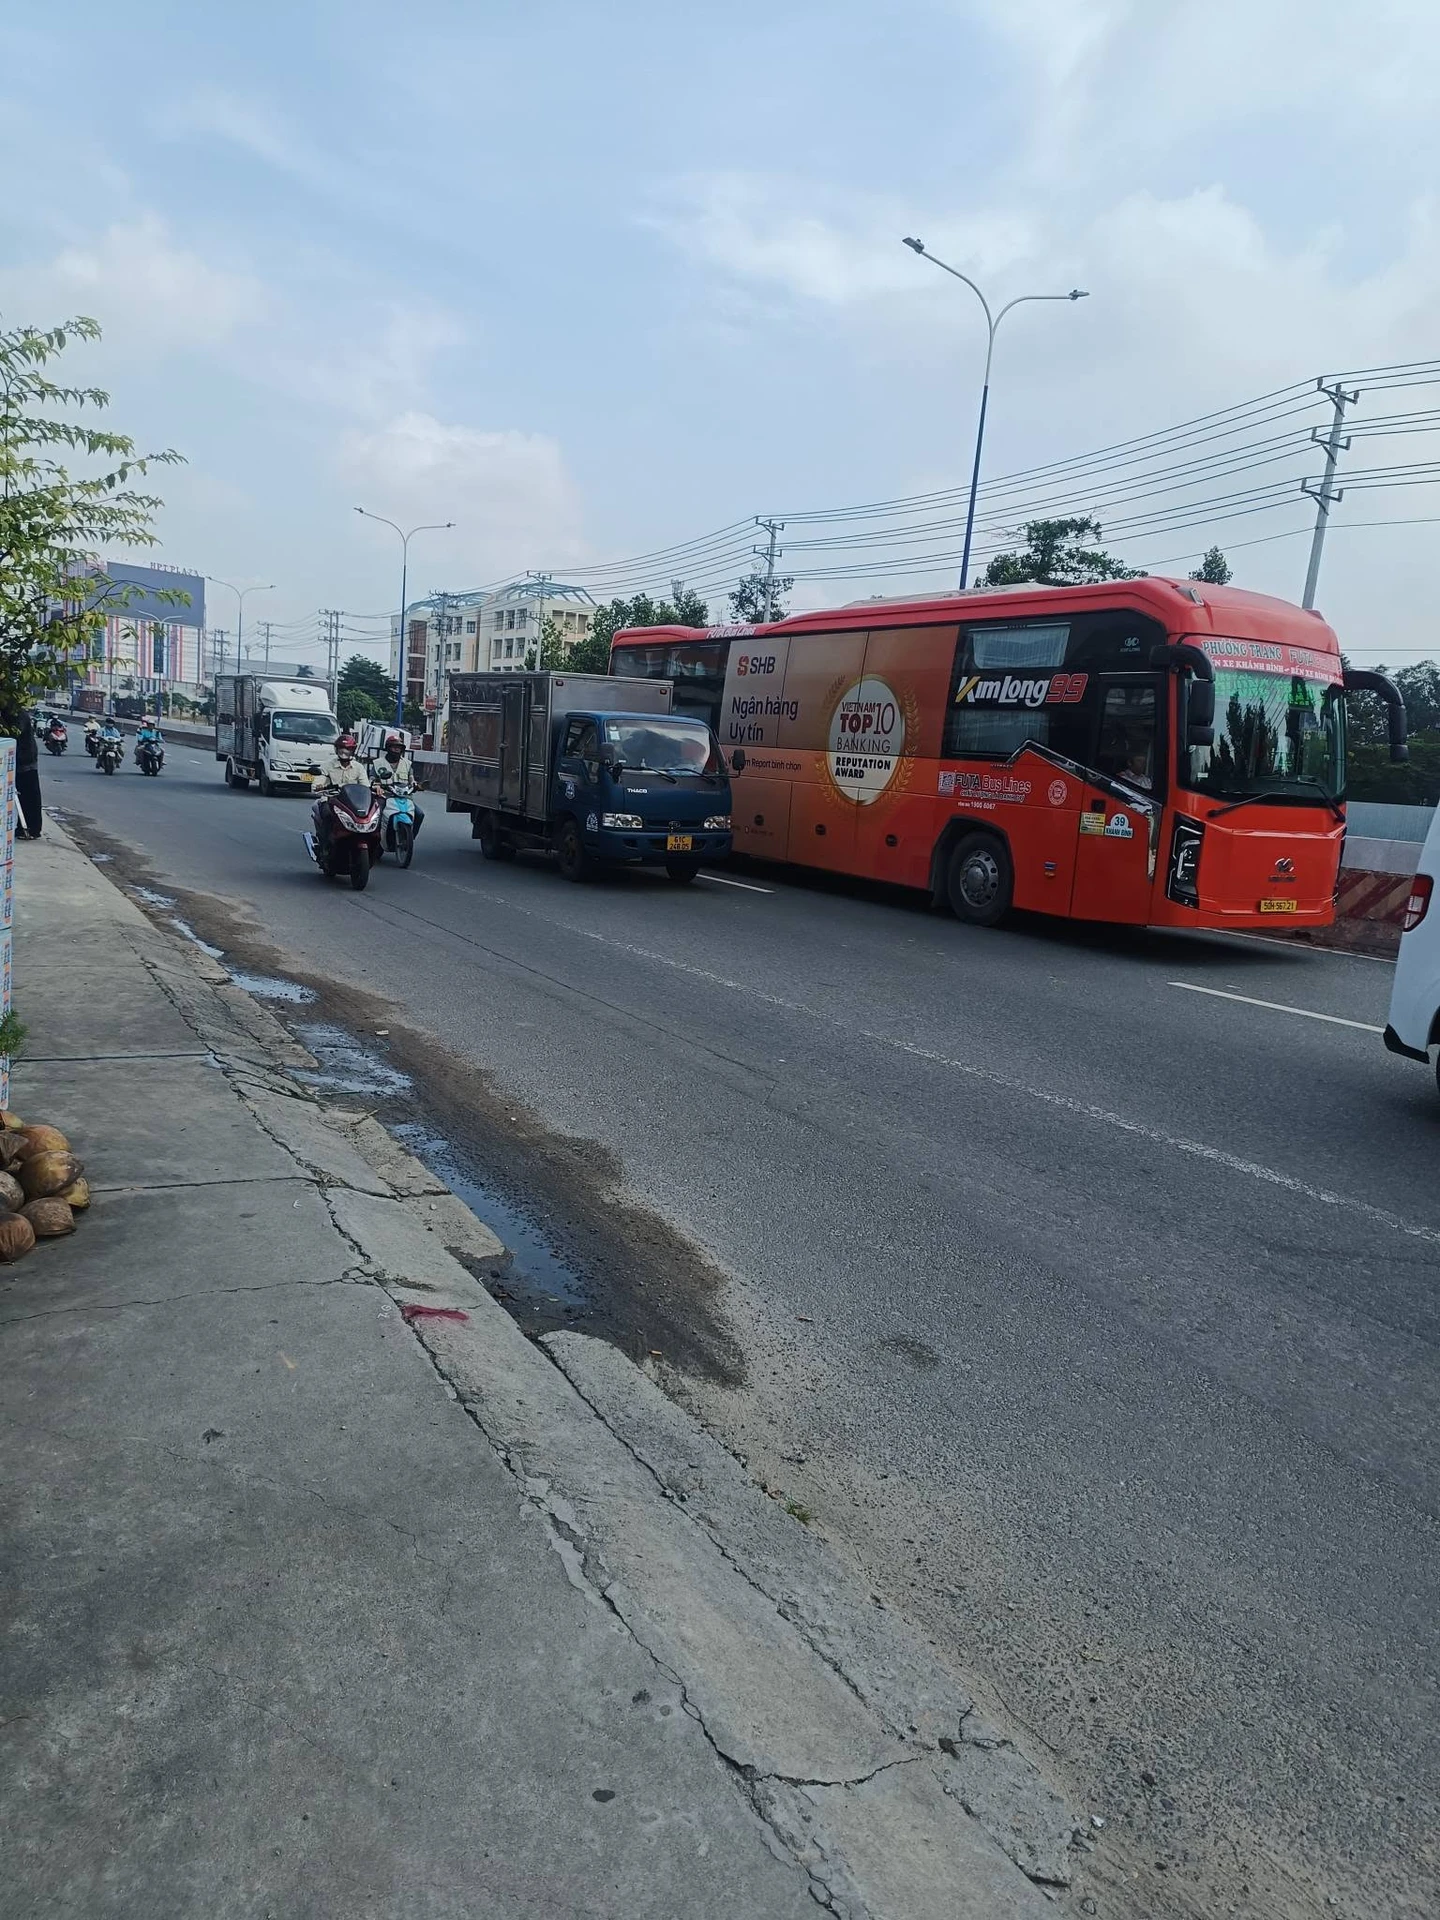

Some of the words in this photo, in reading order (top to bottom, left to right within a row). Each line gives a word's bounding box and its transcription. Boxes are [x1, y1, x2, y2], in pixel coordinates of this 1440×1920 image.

[170, 566, 199, 577] PLAZA
[1202, 639, 1247, 656] PHƯƠNG
[1249, 644, 1282, 660] TRANG
[1222, 659, 1235, 668] XE
[1236, 659, 1265, 671] KHÁNH
[731, 696, 763, 719] Ngân
[764, 696, 799, 720] hàng
[841, 701, 876, 713] VIETNAM
[840, 713, 873, 734] TOP
[873, 702, 895, 735] 10
[729, 722, 747, 744] Uy
[747, 722, 764, 741] tín
[836, 737, 891, 754] BANKING
[751, 758, 771, 769] Report
[835, 757, 891, 770] REPUTATION
[835, 768, 865, 779] AWARD
[955, 772, 982, 789] FUTA
[982, 775, 1002, 792] Bus
[1002, 777, 1032, 794] Lines
[1114, 816, 1126, 827] 39
